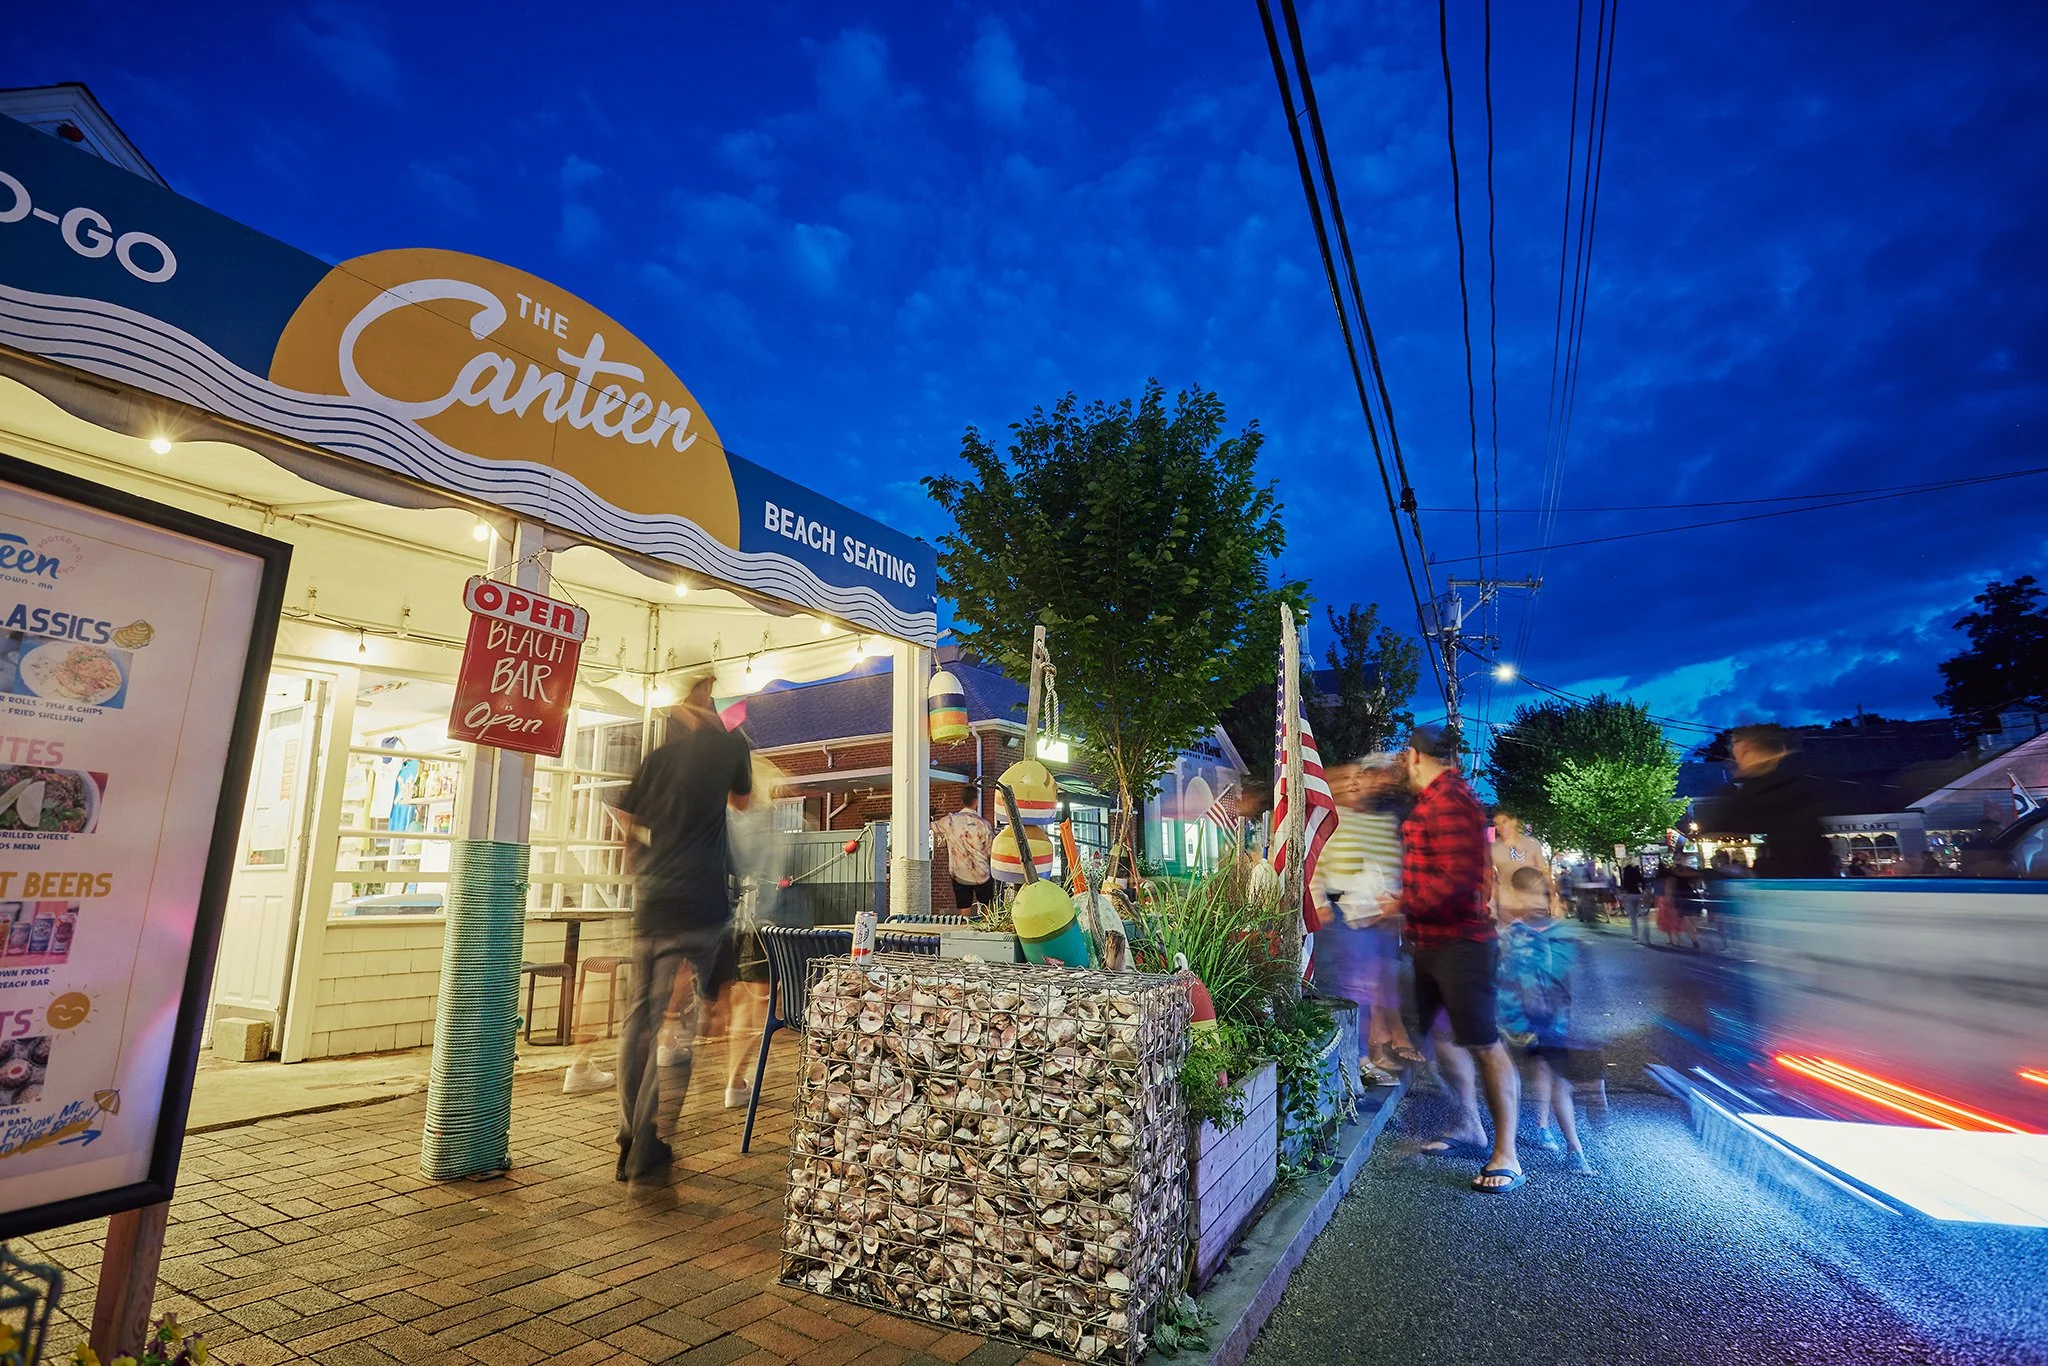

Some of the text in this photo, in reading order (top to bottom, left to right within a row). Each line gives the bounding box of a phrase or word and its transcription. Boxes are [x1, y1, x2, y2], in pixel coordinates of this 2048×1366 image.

[516, 292, 570, 341] THE
[338, 278, 699, 453] Canteen
[764, 500, 917, 588] BEACH SEATING
[38, 582, 54, 591] MA
[486, 619, 566, 664] BEACH
[490, 656, 553, 703] BAR
[8, 696, 37, 706] ROLLS
[76, 706, 104, 715] CHIPS
[8, 708, 84, 724] FRIED SHELLFISH
[504, 702, 513, 711] is
[464, 701, 544, 740] Open
[36, 833, 69, 841] CHEESE
[1838, 823, 1857, 831] THE
[1862, 821, 1890, 830] CAPE
[13, 843, 41, 851] MENU
[22, 871, 113, 898] BEERS
[30, 979, 50, 987] BAR
[3, 1100, 85, 1144] FOLLOW ME
[8, 1116, 33, 1127] BARS
[49, 1107, 94, 1137] BEACH
